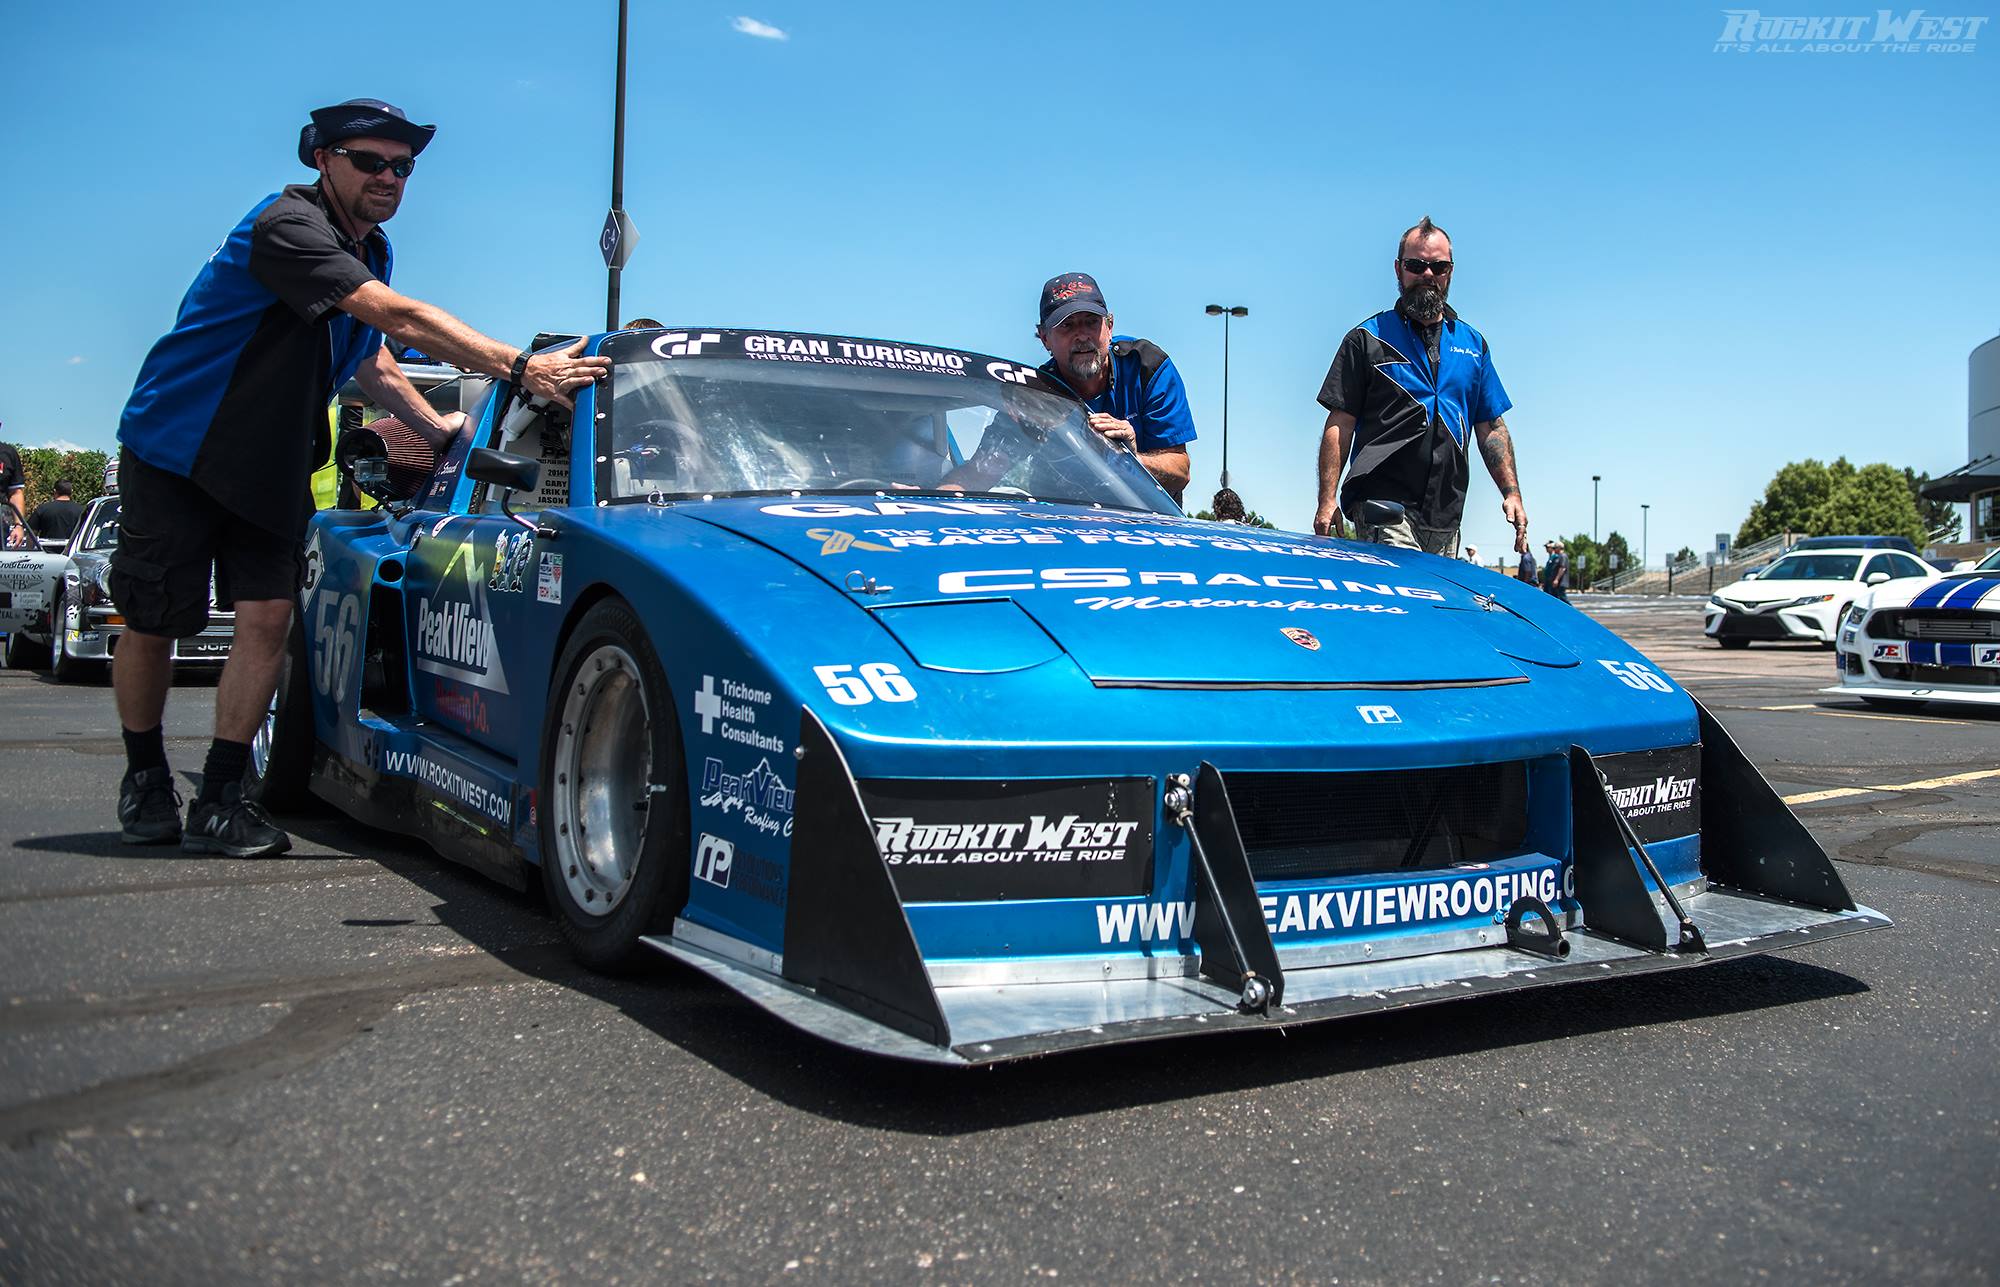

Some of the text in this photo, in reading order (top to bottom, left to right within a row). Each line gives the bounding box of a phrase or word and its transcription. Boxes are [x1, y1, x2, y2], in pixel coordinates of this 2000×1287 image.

[745, 335, 829, 356] GRAN
[746, 352, 967, 376] THE REAL DRIVING SIMULATOR
[538, 496, 563, 504] JASON
[864, 529, 933, 538] The
[938, 527, 1032, 536] Grace
[889, 534, 1063, 548] RACE
[1077, 534, 1200, 548] FOR
[1074, 596, 1408, 615] Motorsports
[314, 589, 361, 703] 56
[1981, 649, 2000, 663] J
[812, 662, 918, 706] 56
[1596, 659, 1675, 693] 56
[722, 679, 772, 705] Trichome
[721, 700, 755, 725] Health
[721, 722, 784, 754] Consultants
[1626, 805, 1656, 818] ABOUT
[1656, 802, 1673, 813] THE
[1673, 799, 1692, 811] RIDE
[1020, 815, 1139, 850] WEST
[906, 852, 948, 865] ALL
[951, 851, 1029, 864] ABOUT
[1031, 850, 1072, 862] THE
[1076, 848, 1126, 862] RIDE
